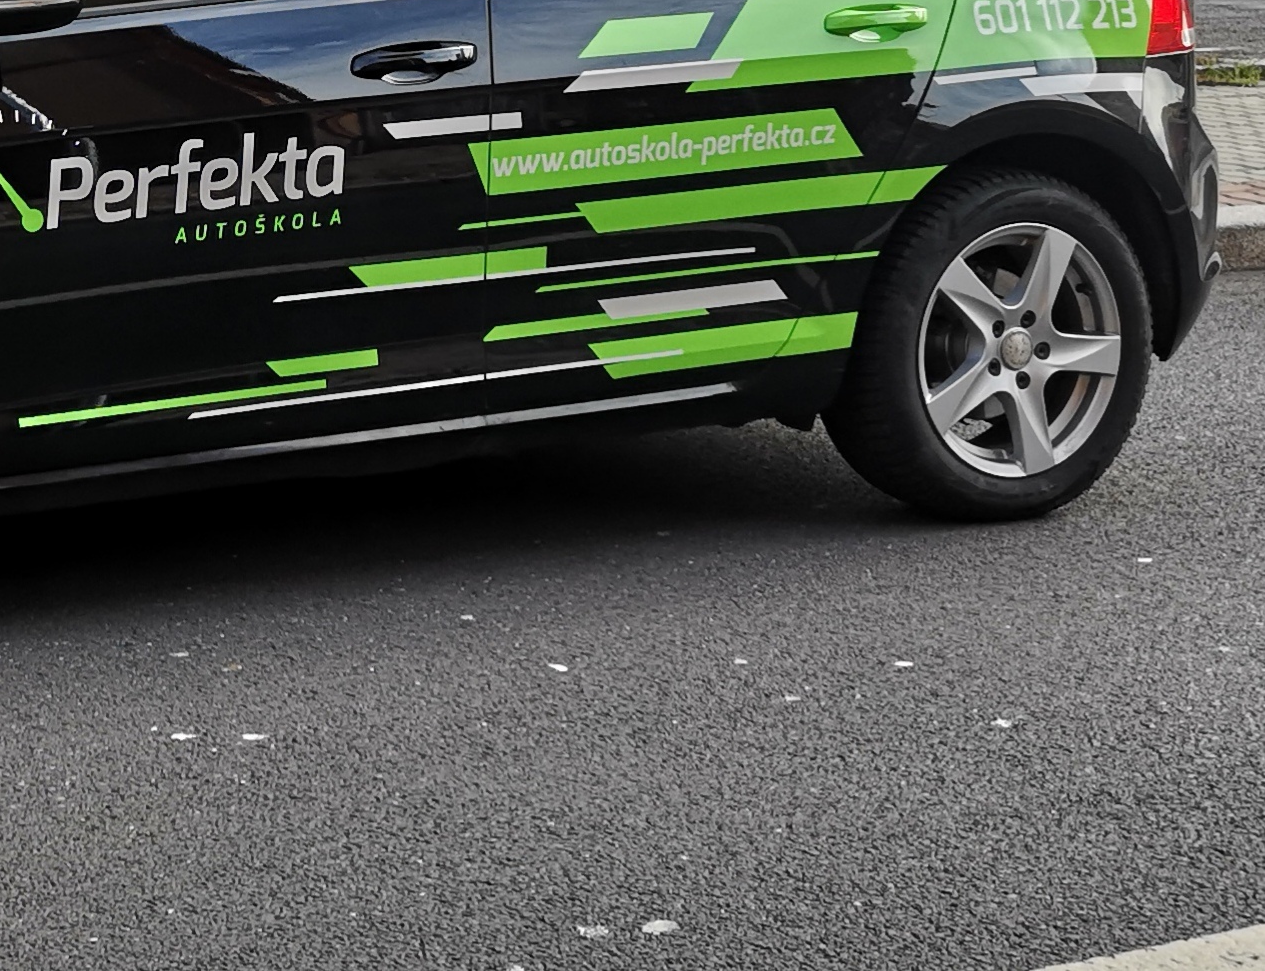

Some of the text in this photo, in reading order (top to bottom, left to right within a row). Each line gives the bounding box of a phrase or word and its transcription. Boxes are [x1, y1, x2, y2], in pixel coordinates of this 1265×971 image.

[491, 120, 837, 179] www.autoskola-perfekta.cz
[46, 132, 346, 230] Perfekta
[175, 208, 342, 244] AUTOŠKOLA
